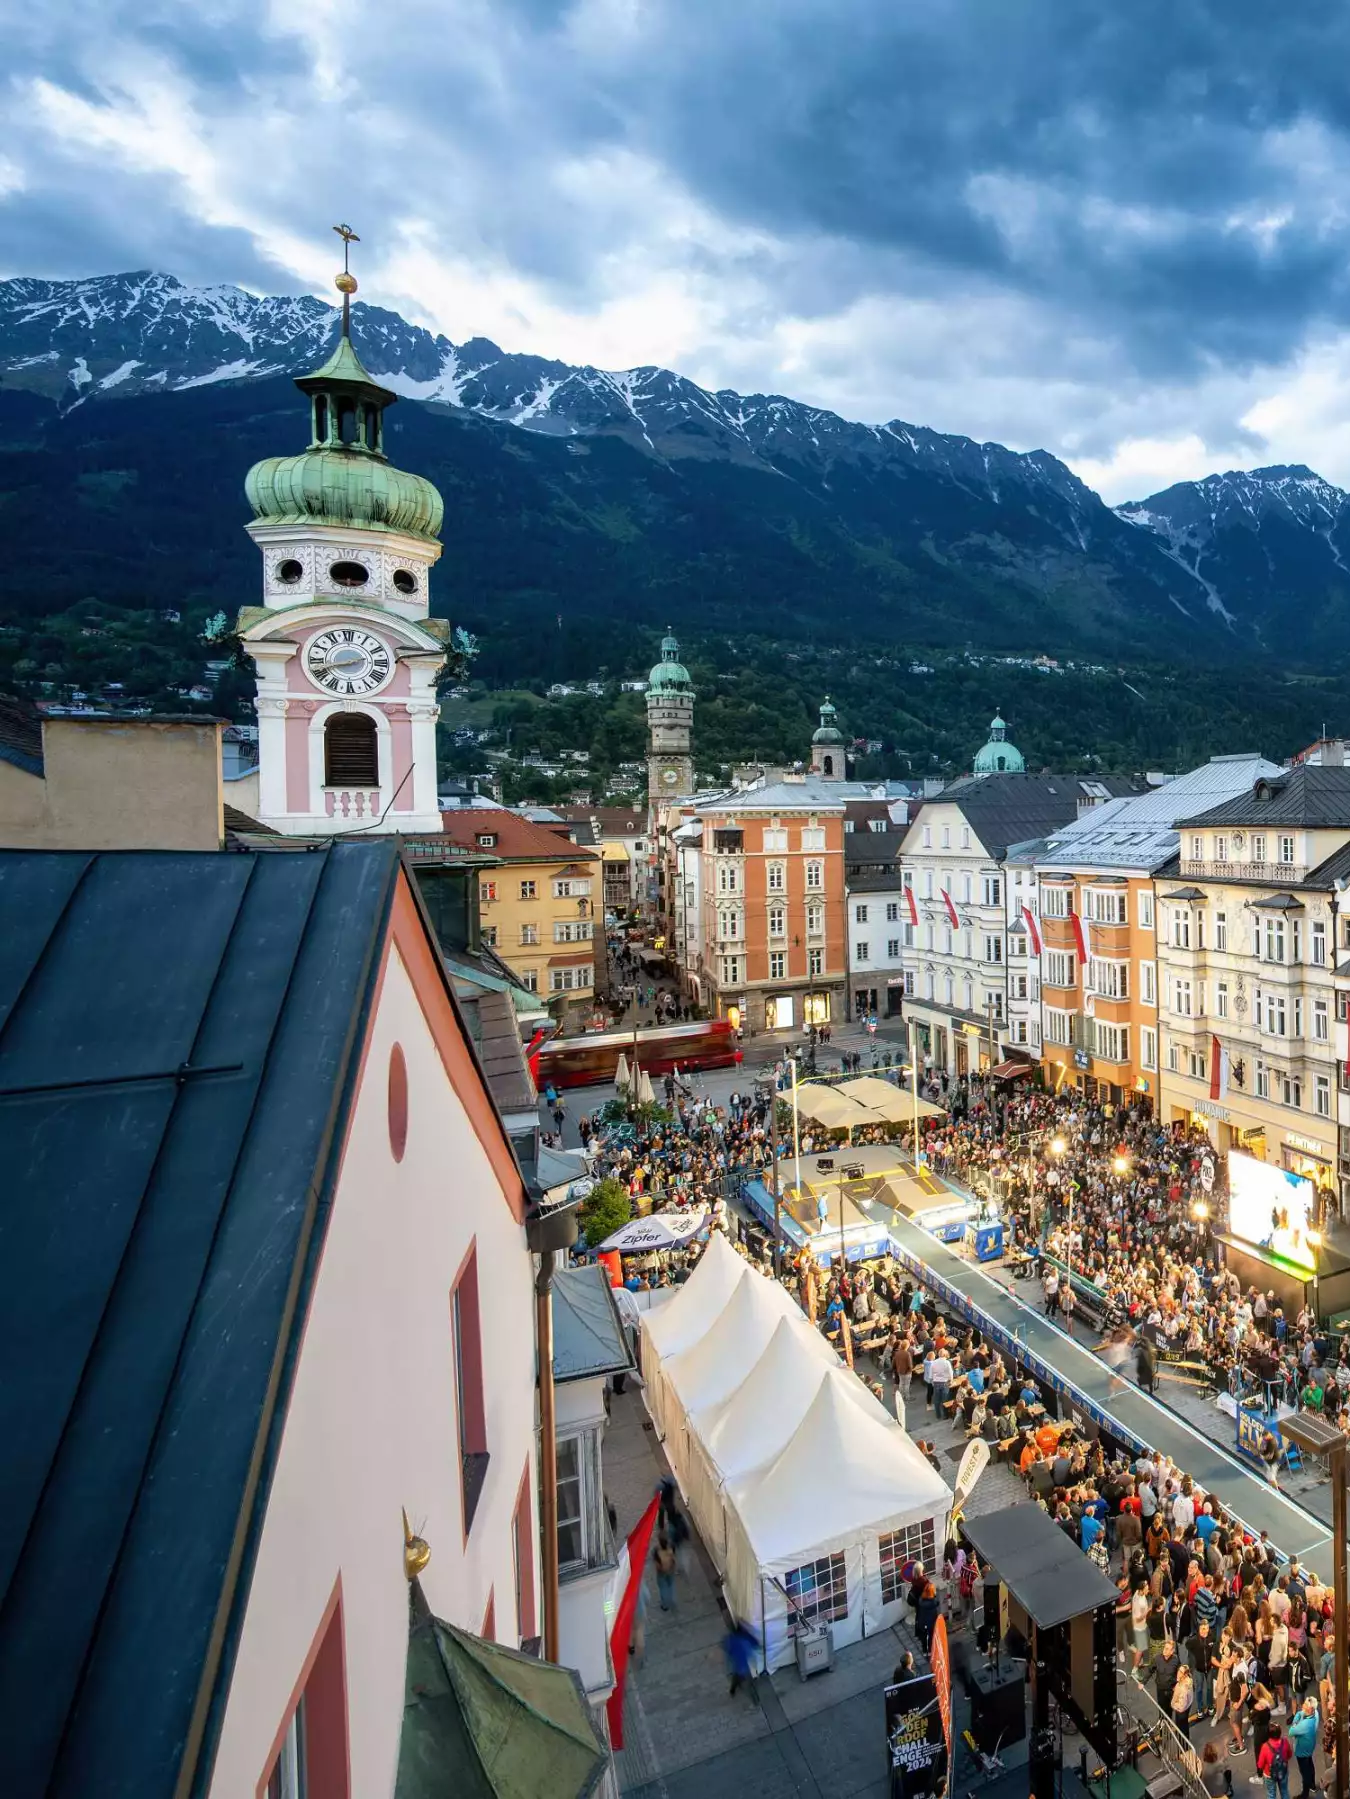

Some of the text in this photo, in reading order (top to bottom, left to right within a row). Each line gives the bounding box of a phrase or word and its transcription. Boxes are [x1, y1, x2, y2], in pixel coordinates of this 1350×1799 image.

[622, 1233, 661, 1246] Zipfer
[896, 1728, 927, 1745] ROOF
[894, 1737, 930, 1755] CHALL
[893, 1748, 922, 1766] ENGE
[906, 1757, 932, 1773] 2024
